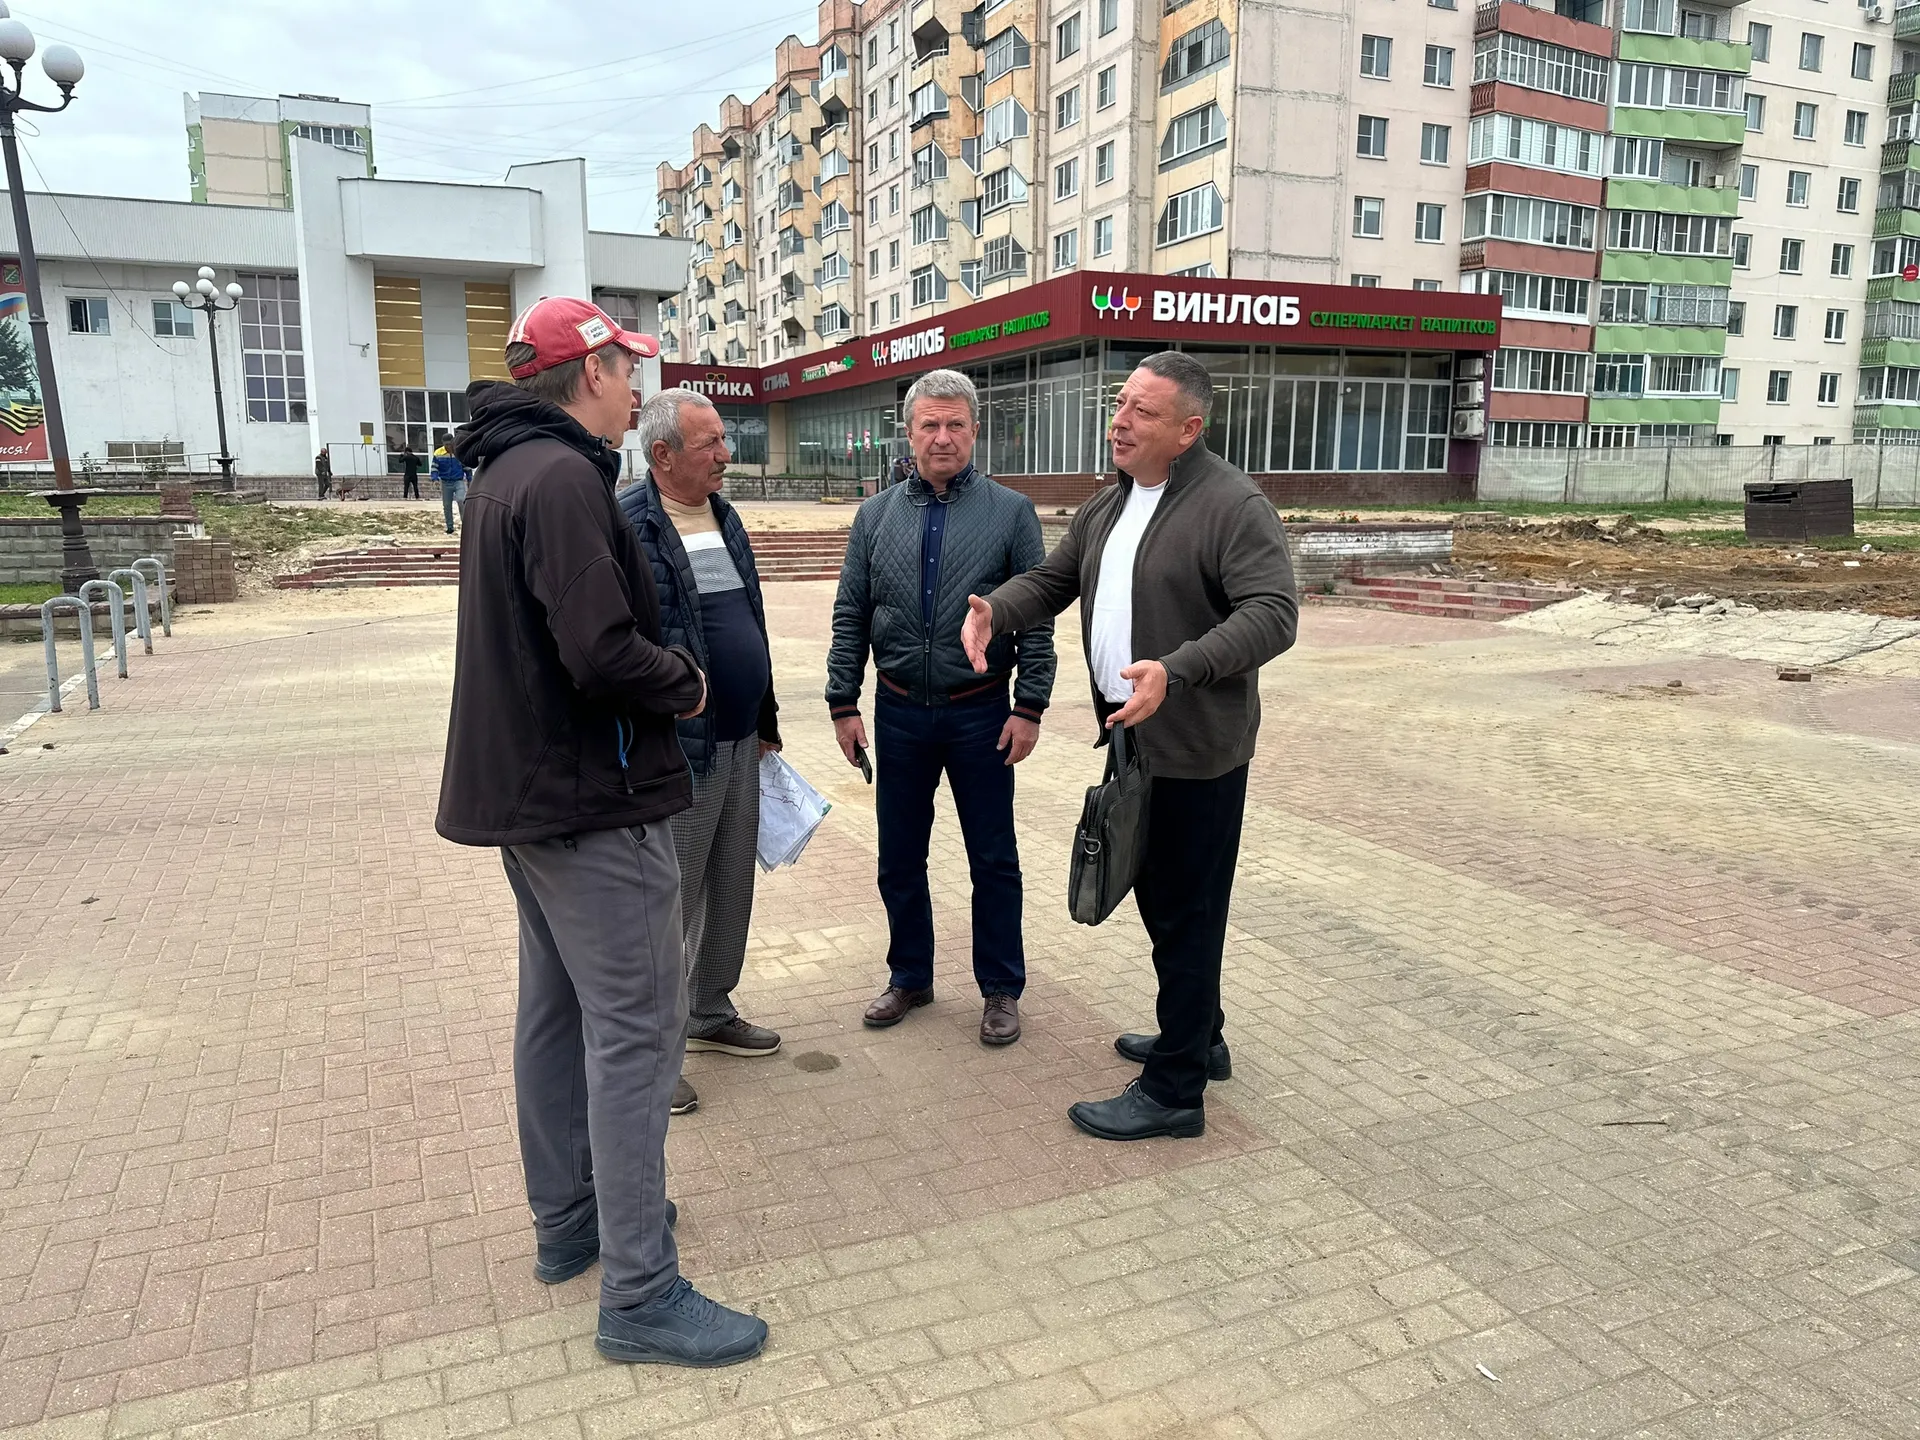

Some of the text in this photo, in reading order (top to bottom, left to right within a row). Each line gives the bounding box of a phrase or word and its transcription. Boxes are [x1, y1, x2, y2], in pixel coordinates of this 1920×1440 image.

[949, 310, 1050, 349] СУПЕРМАРКЕТ НАПИТКОВ
[1310, 311, 1496, 335] СУПЕРМАРКЕТ НАПИТКОВ
[680, 379, 754, 397] ОПТИКА
